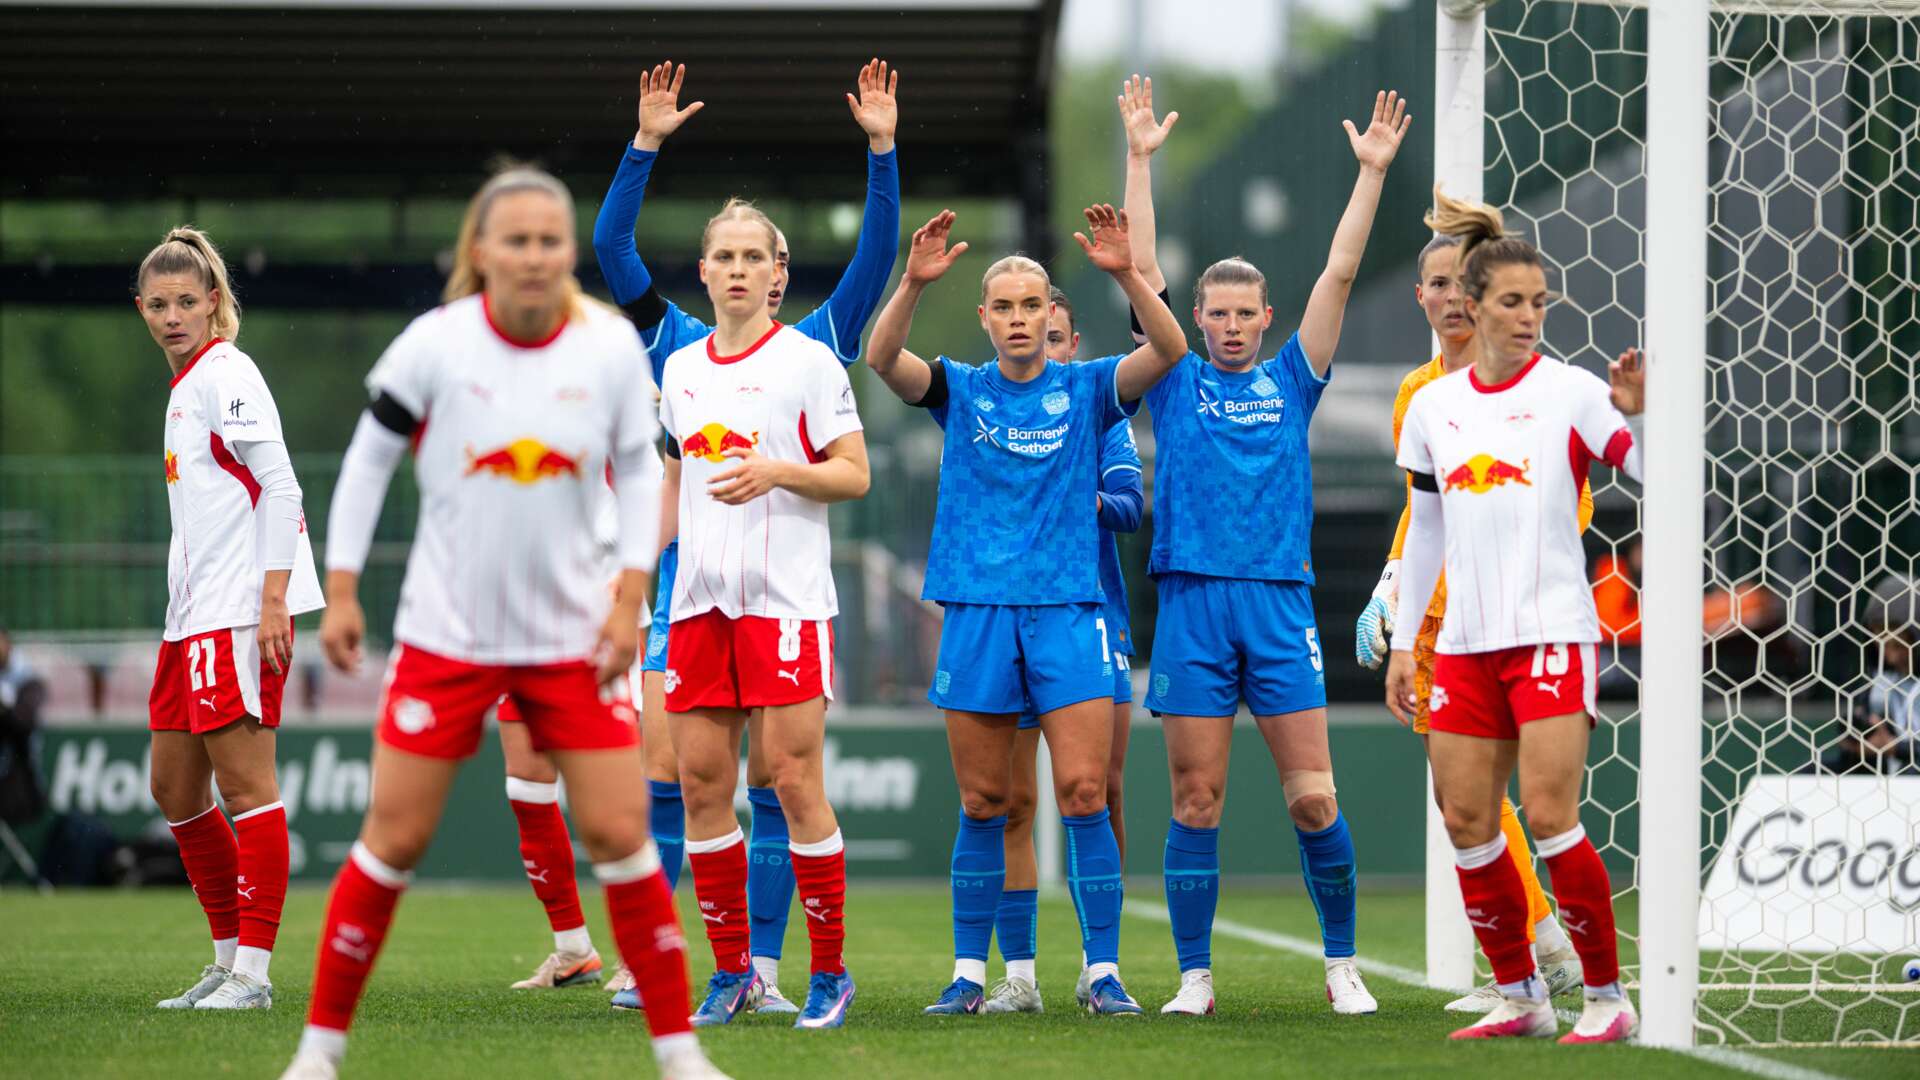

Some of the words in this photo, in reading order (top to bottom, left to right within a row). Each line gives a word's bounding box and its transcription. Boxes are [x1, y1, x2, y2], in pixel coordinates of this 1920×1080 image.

[1007, 423, 1069, 440] Barmenia
[1007, 439, 1064, 453] Gothaer
[778, 618, 801, 662] 8
[1305, 627, 1323, 671] 5
[52, 736, 304, 823] Holy
